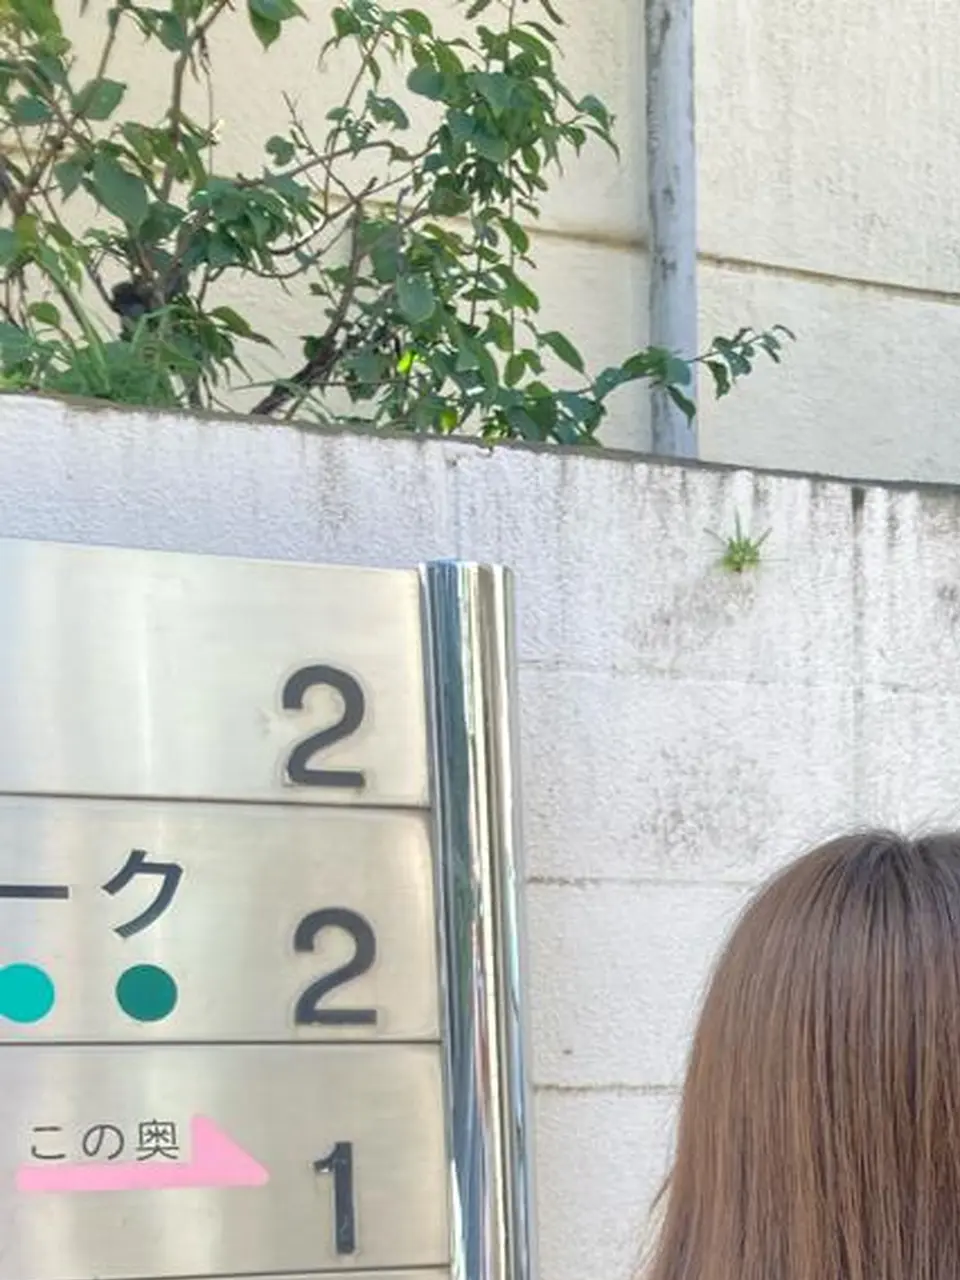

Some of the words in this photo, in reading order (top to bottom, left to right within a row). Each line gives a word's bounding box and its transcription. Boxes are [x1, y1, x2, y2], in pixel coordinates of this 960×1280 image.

[282, 664, 365, 788] 2
[293, 907, 377, 1026] 2
[30, 1119, 180, 1162] この奥
[311, 1142, 357, 1255] 1
